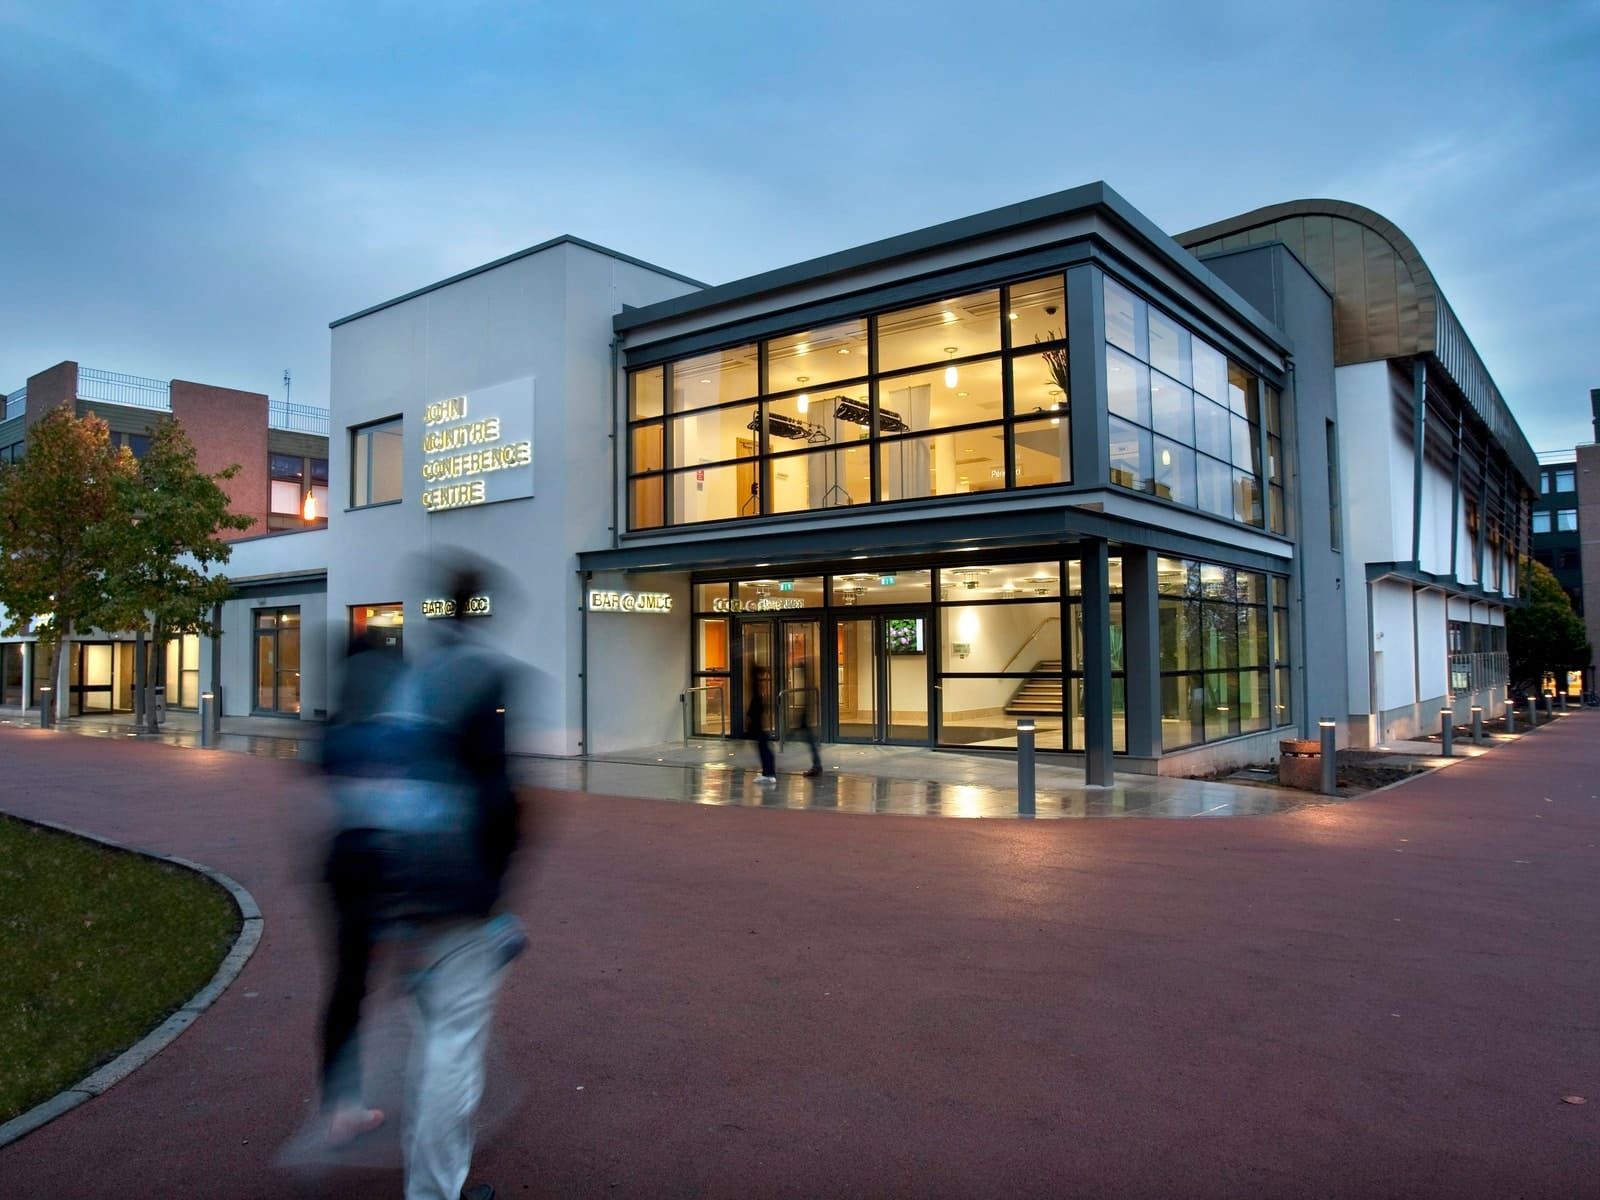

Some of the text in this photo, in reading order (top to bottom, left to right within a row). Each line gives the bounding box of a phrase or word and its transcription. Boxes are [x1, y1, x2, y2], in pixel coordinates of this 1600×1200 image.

[424, 396, 467, 426] JOHN
[423, 441, 531, 481] CONFERENCE
[423, 480, 486, 511] CENTRE
[422, 599, 445, 616] BAR
[590, 591, 621, 610] BAR
[621, 593, 637, 612] @
